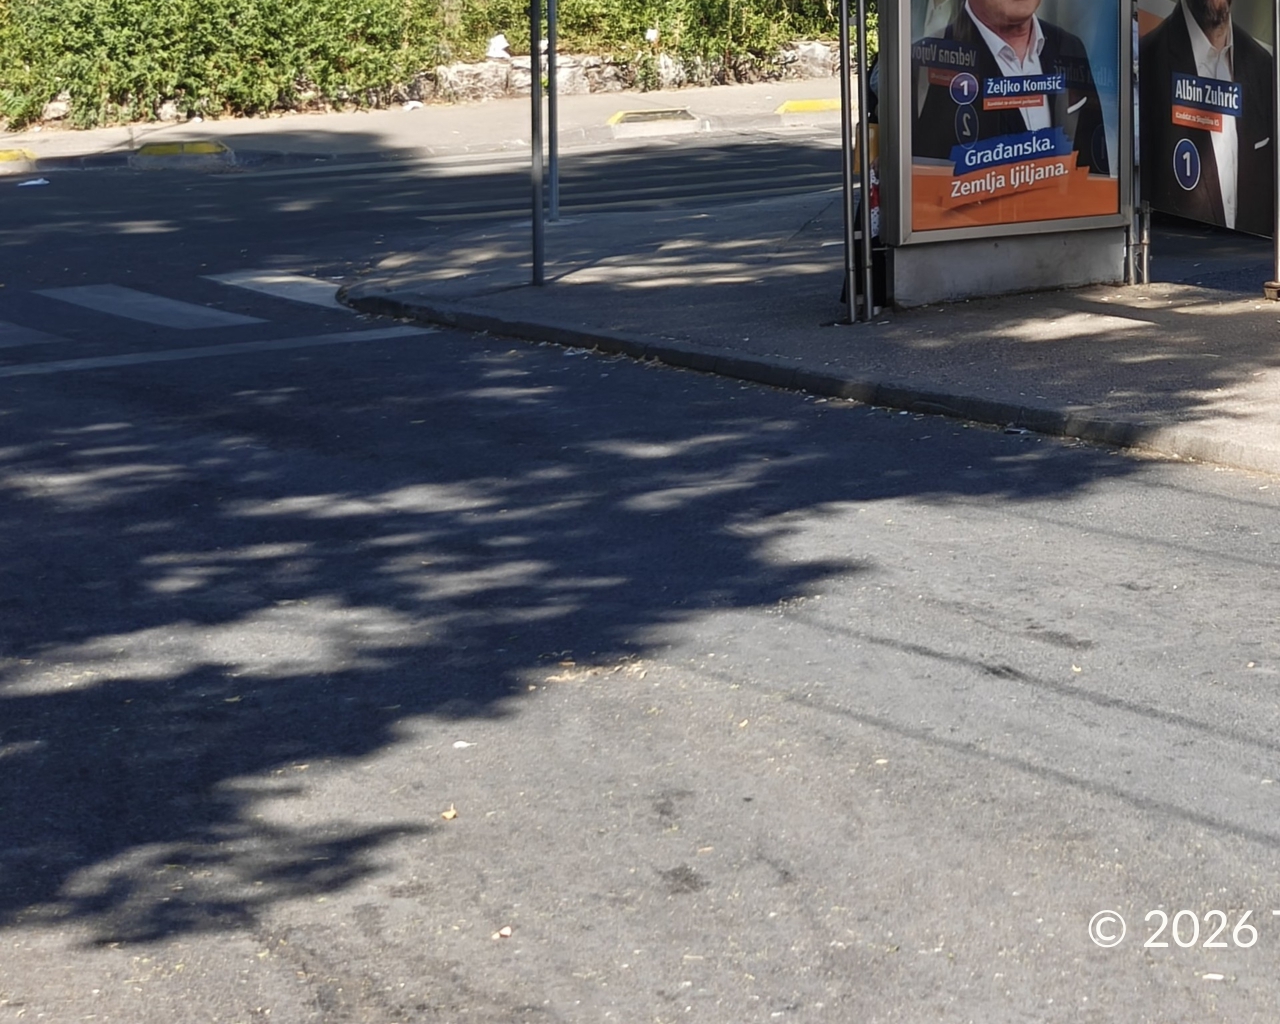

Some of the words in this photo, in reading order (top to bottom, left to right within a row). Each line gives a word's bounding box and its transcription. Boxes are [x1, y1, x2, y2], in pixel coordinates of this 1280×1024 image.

[960, 80, 969, 96] 1
[987, 78, 1020, 96] Željko
[1023, 76, 1062, 92] Komšić
[1175, 79, 1203, 103] Albin
[1204, 85, 1239, 109] Zuhrić
[965, 136, 1055, 166] Građanska.
[1182, 151, 1191, 176] 1
[951, 171, 1005, 198] Zemlja
[1010, 163, 1069, 188] ljiljana.
